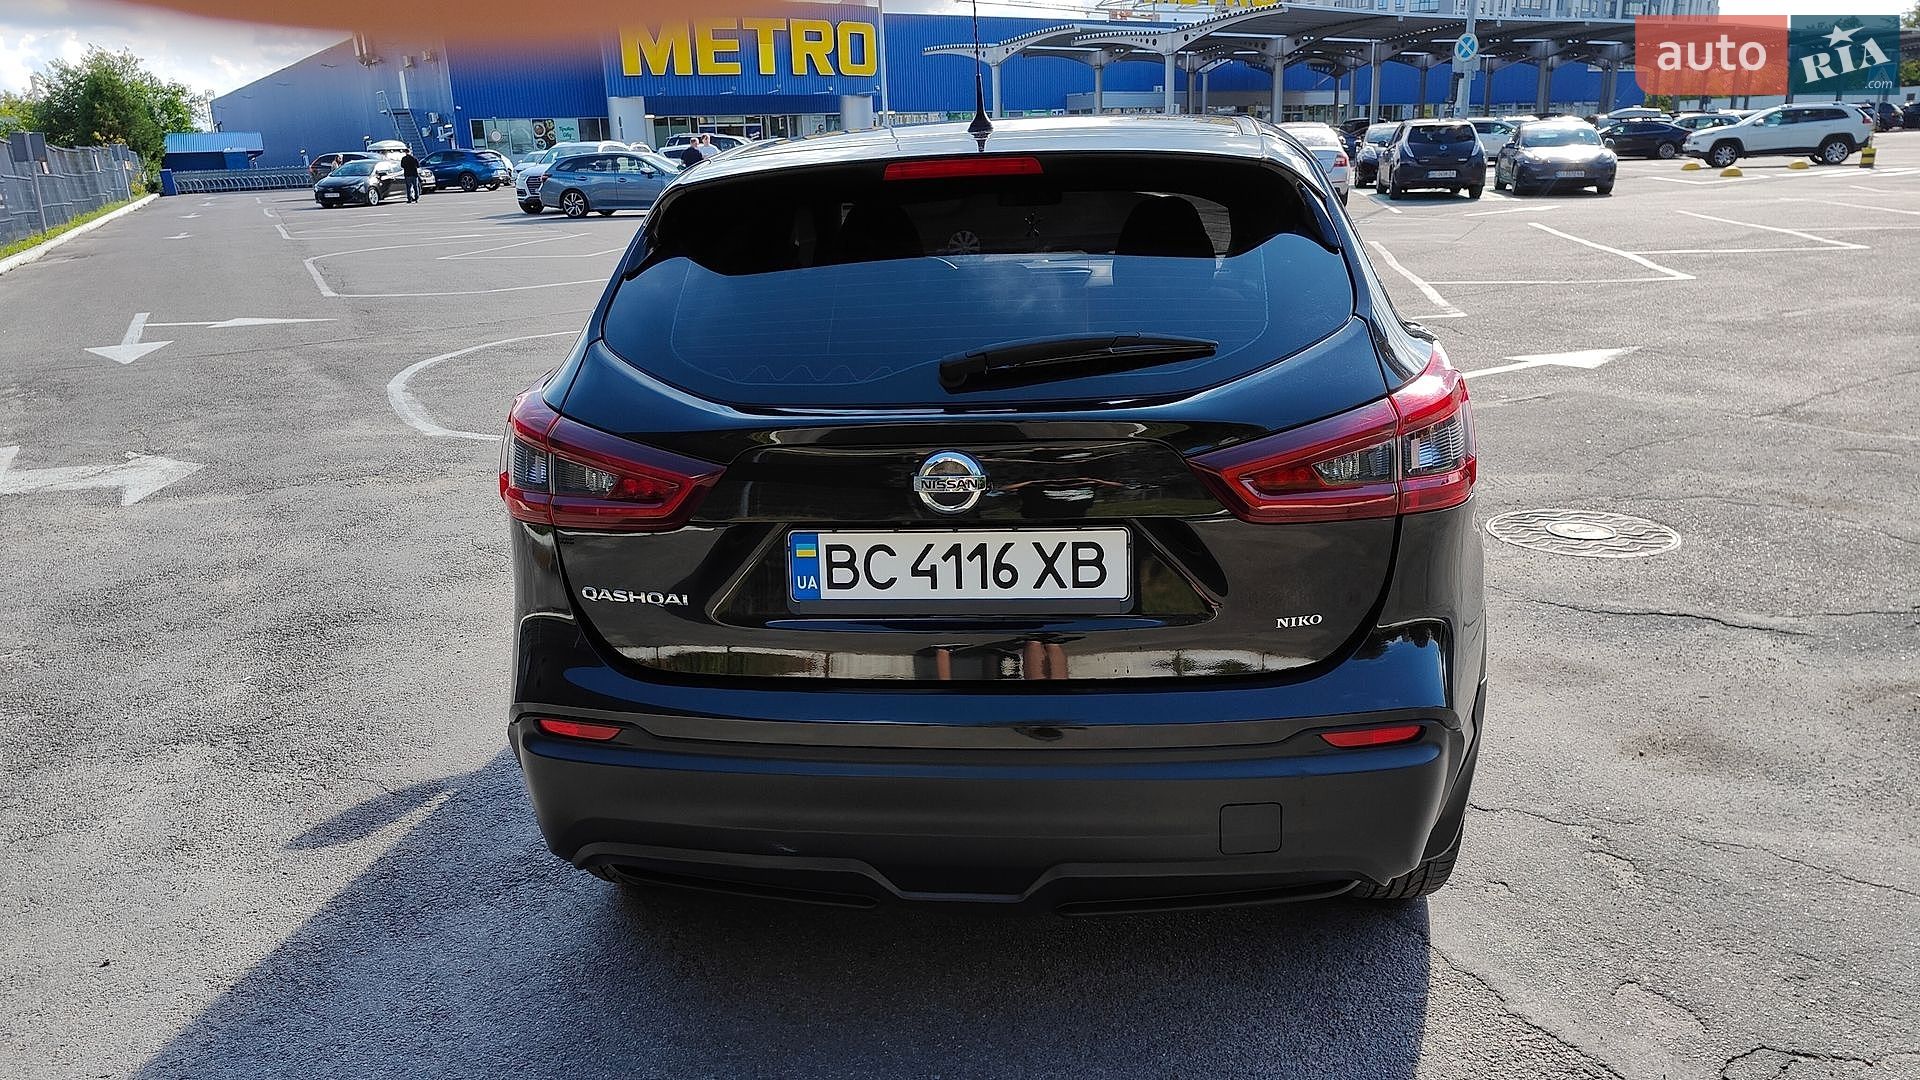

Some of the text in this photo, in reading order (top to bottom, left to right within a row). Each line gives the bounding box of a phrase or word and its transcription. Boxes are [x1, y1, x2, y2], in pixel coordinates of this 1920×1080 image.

[619, 18, 877, 76] METRO
[920, 479, 979, 489] NISSAN
[797, 541, 1107, 590] UA BC 4116 XB
[581, 586, 689, 606] QASHQAI
[1276, 614, 1323, 629] NIKO
